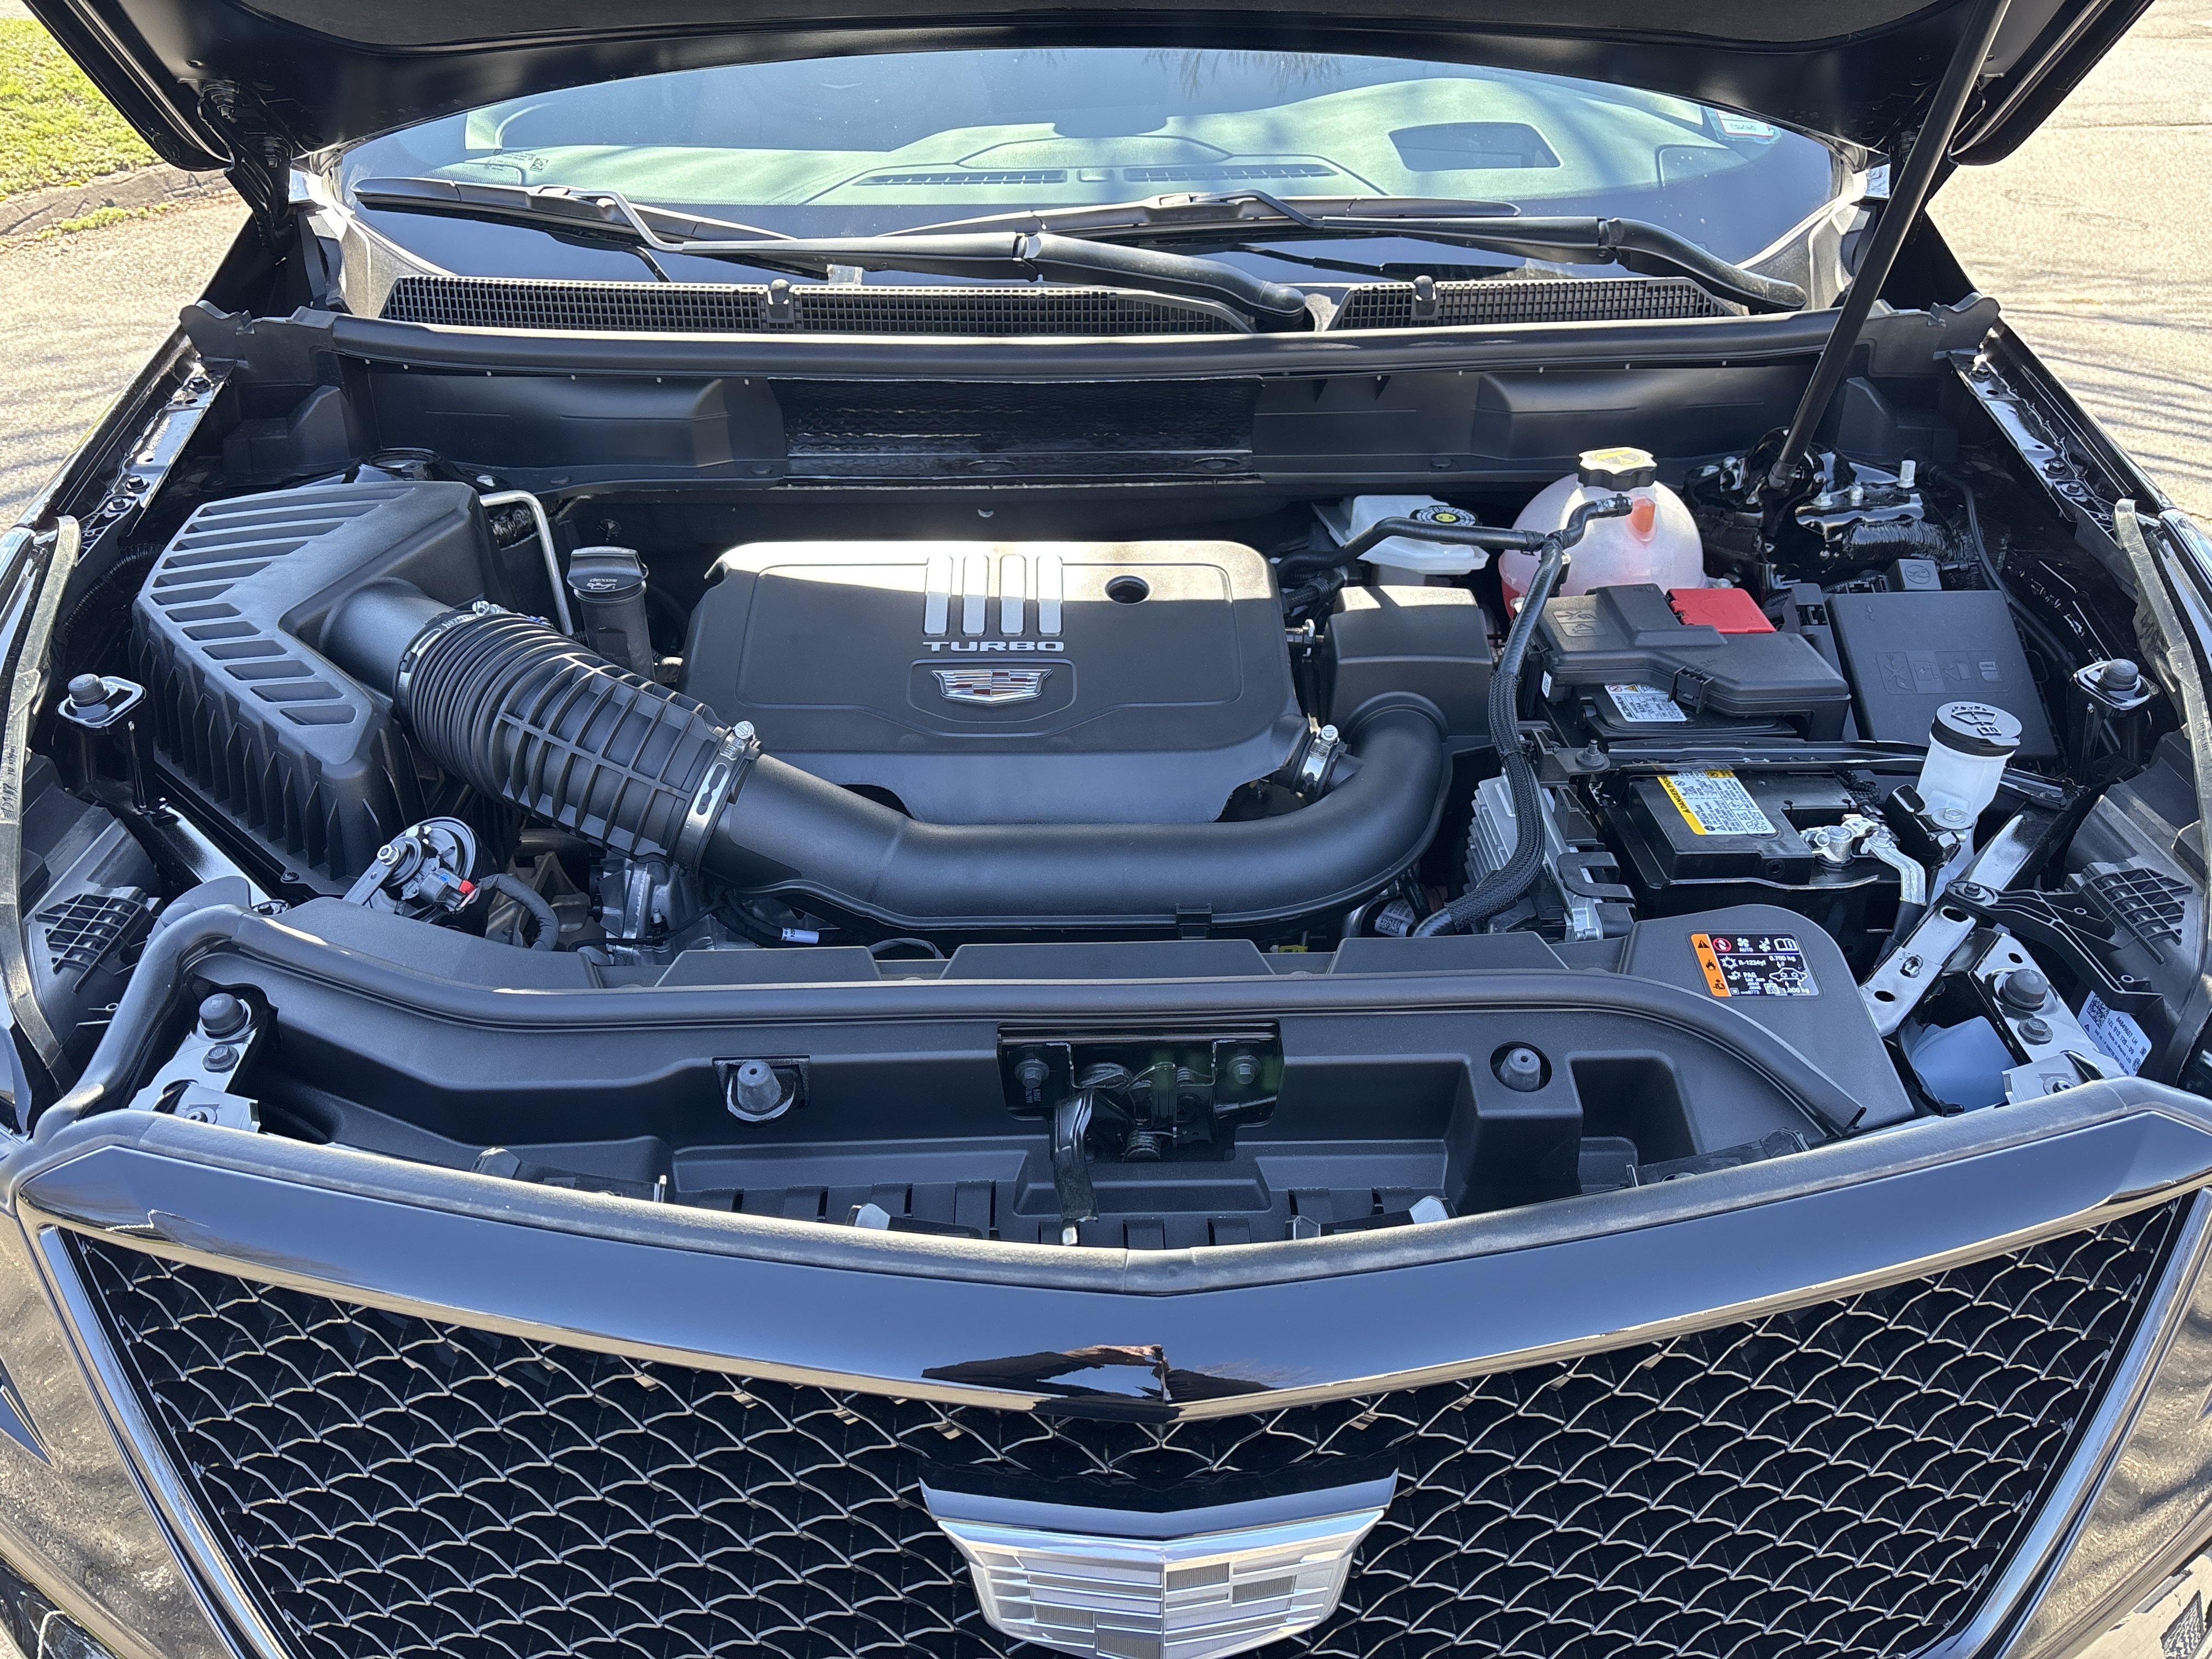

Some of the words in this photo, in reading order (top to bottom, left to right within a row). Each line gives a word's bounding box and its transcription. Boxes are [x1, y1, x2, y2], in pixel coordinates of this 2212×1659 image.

[923, 641, 1064, 653] TURBO
[2131, 1036, 2138, 1046] LH
[2117, 1044, 2126, 1057] Mexico
